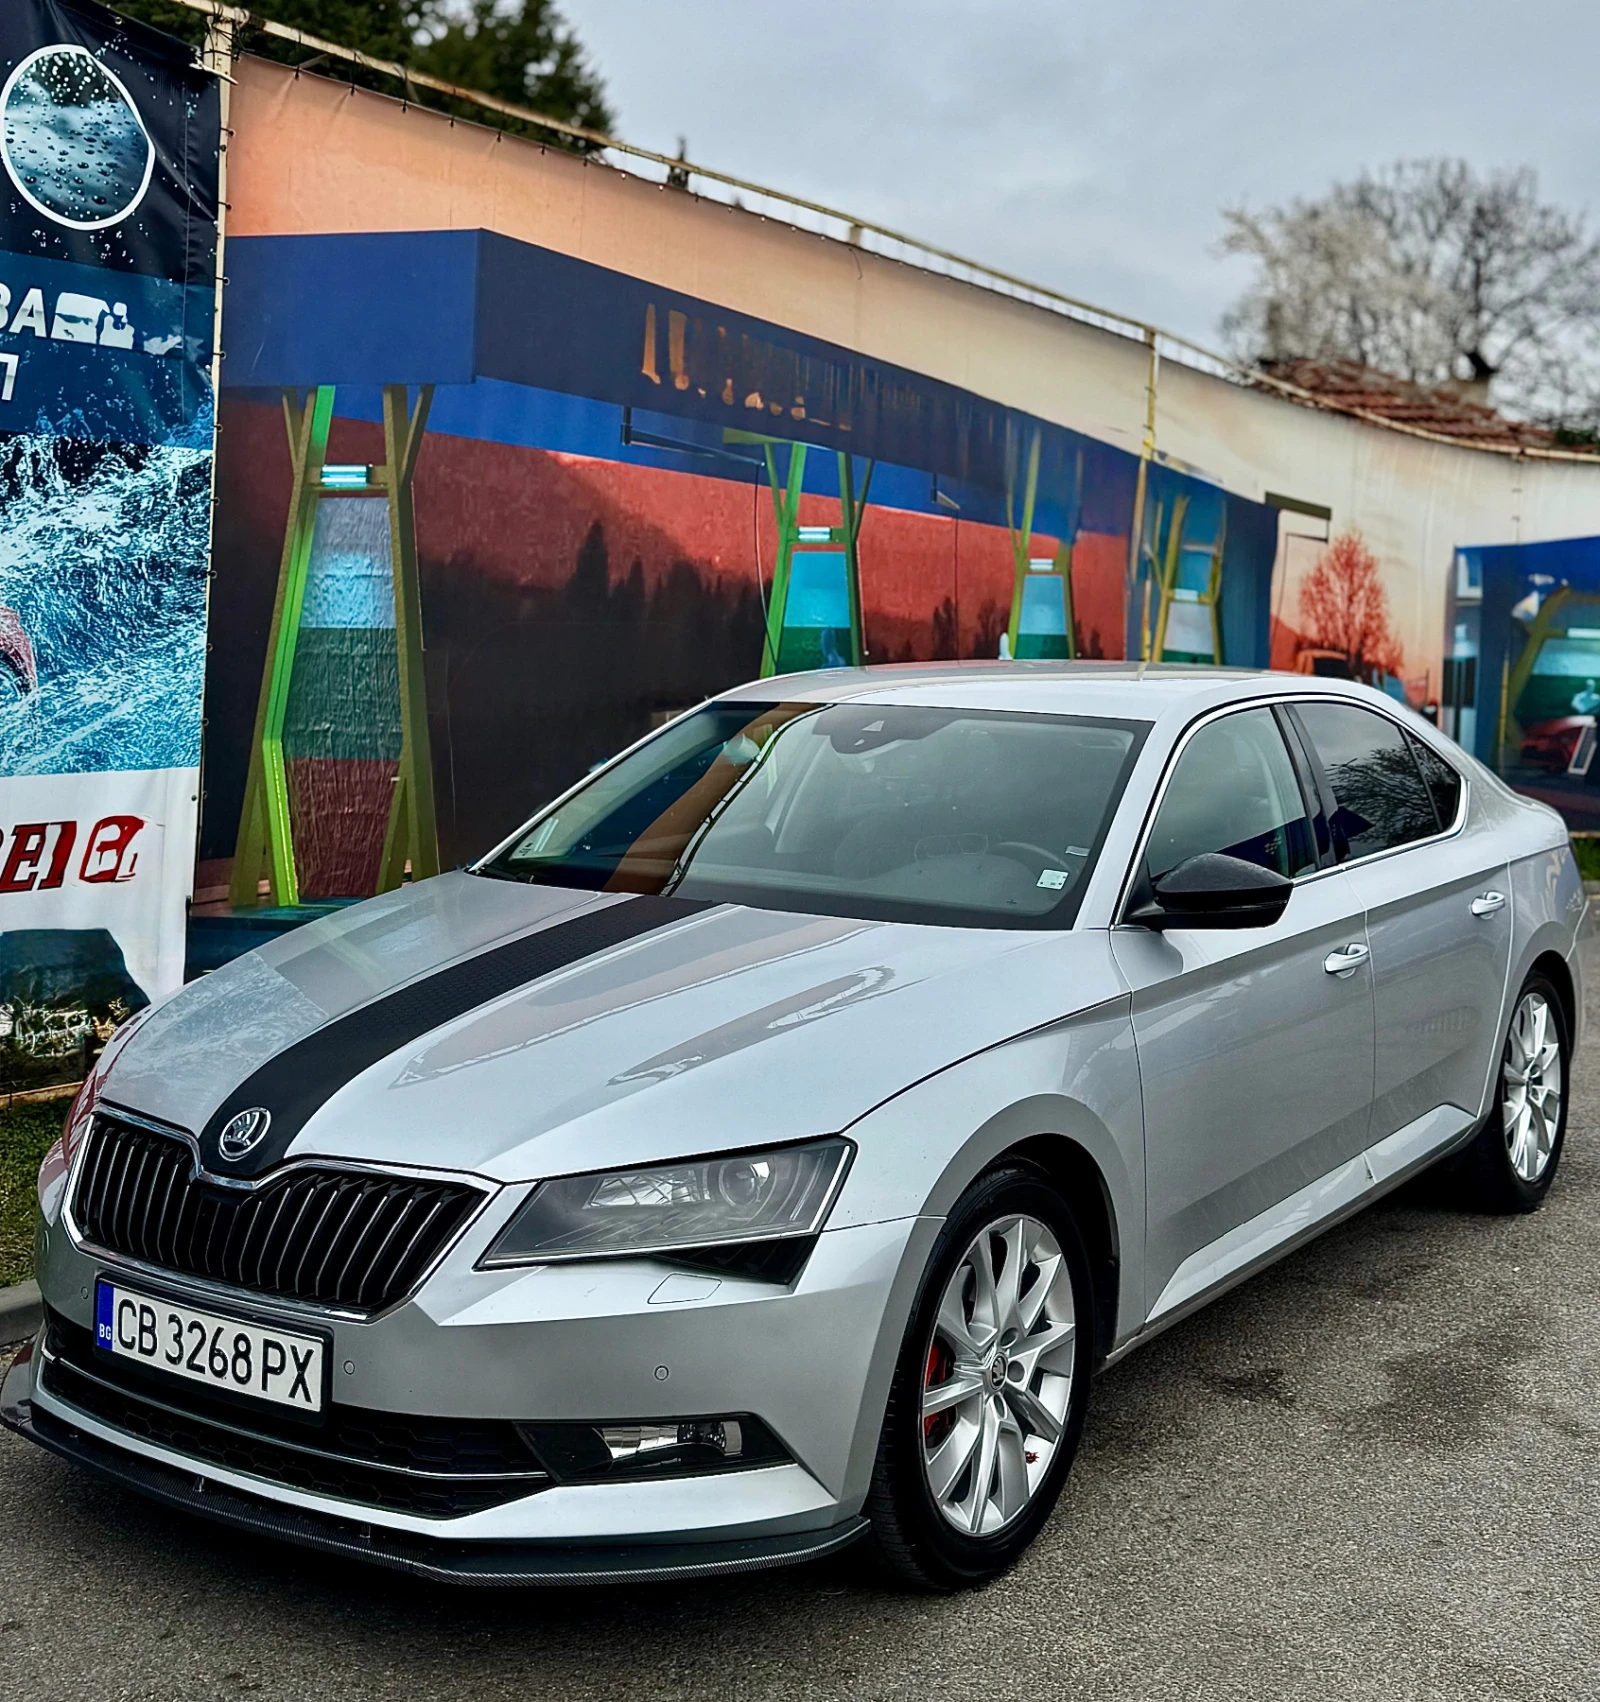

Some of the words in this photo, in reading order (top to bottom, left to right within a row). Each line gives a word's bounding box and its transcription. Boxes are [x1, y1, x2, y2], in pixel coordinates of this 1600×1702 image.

[98, 1323, 112, 1340] BG
[117, 1298, 158, 1357] CB
[165, 1313, 252, 1385] 3268
[261, 1338, 314, 1403] PX
